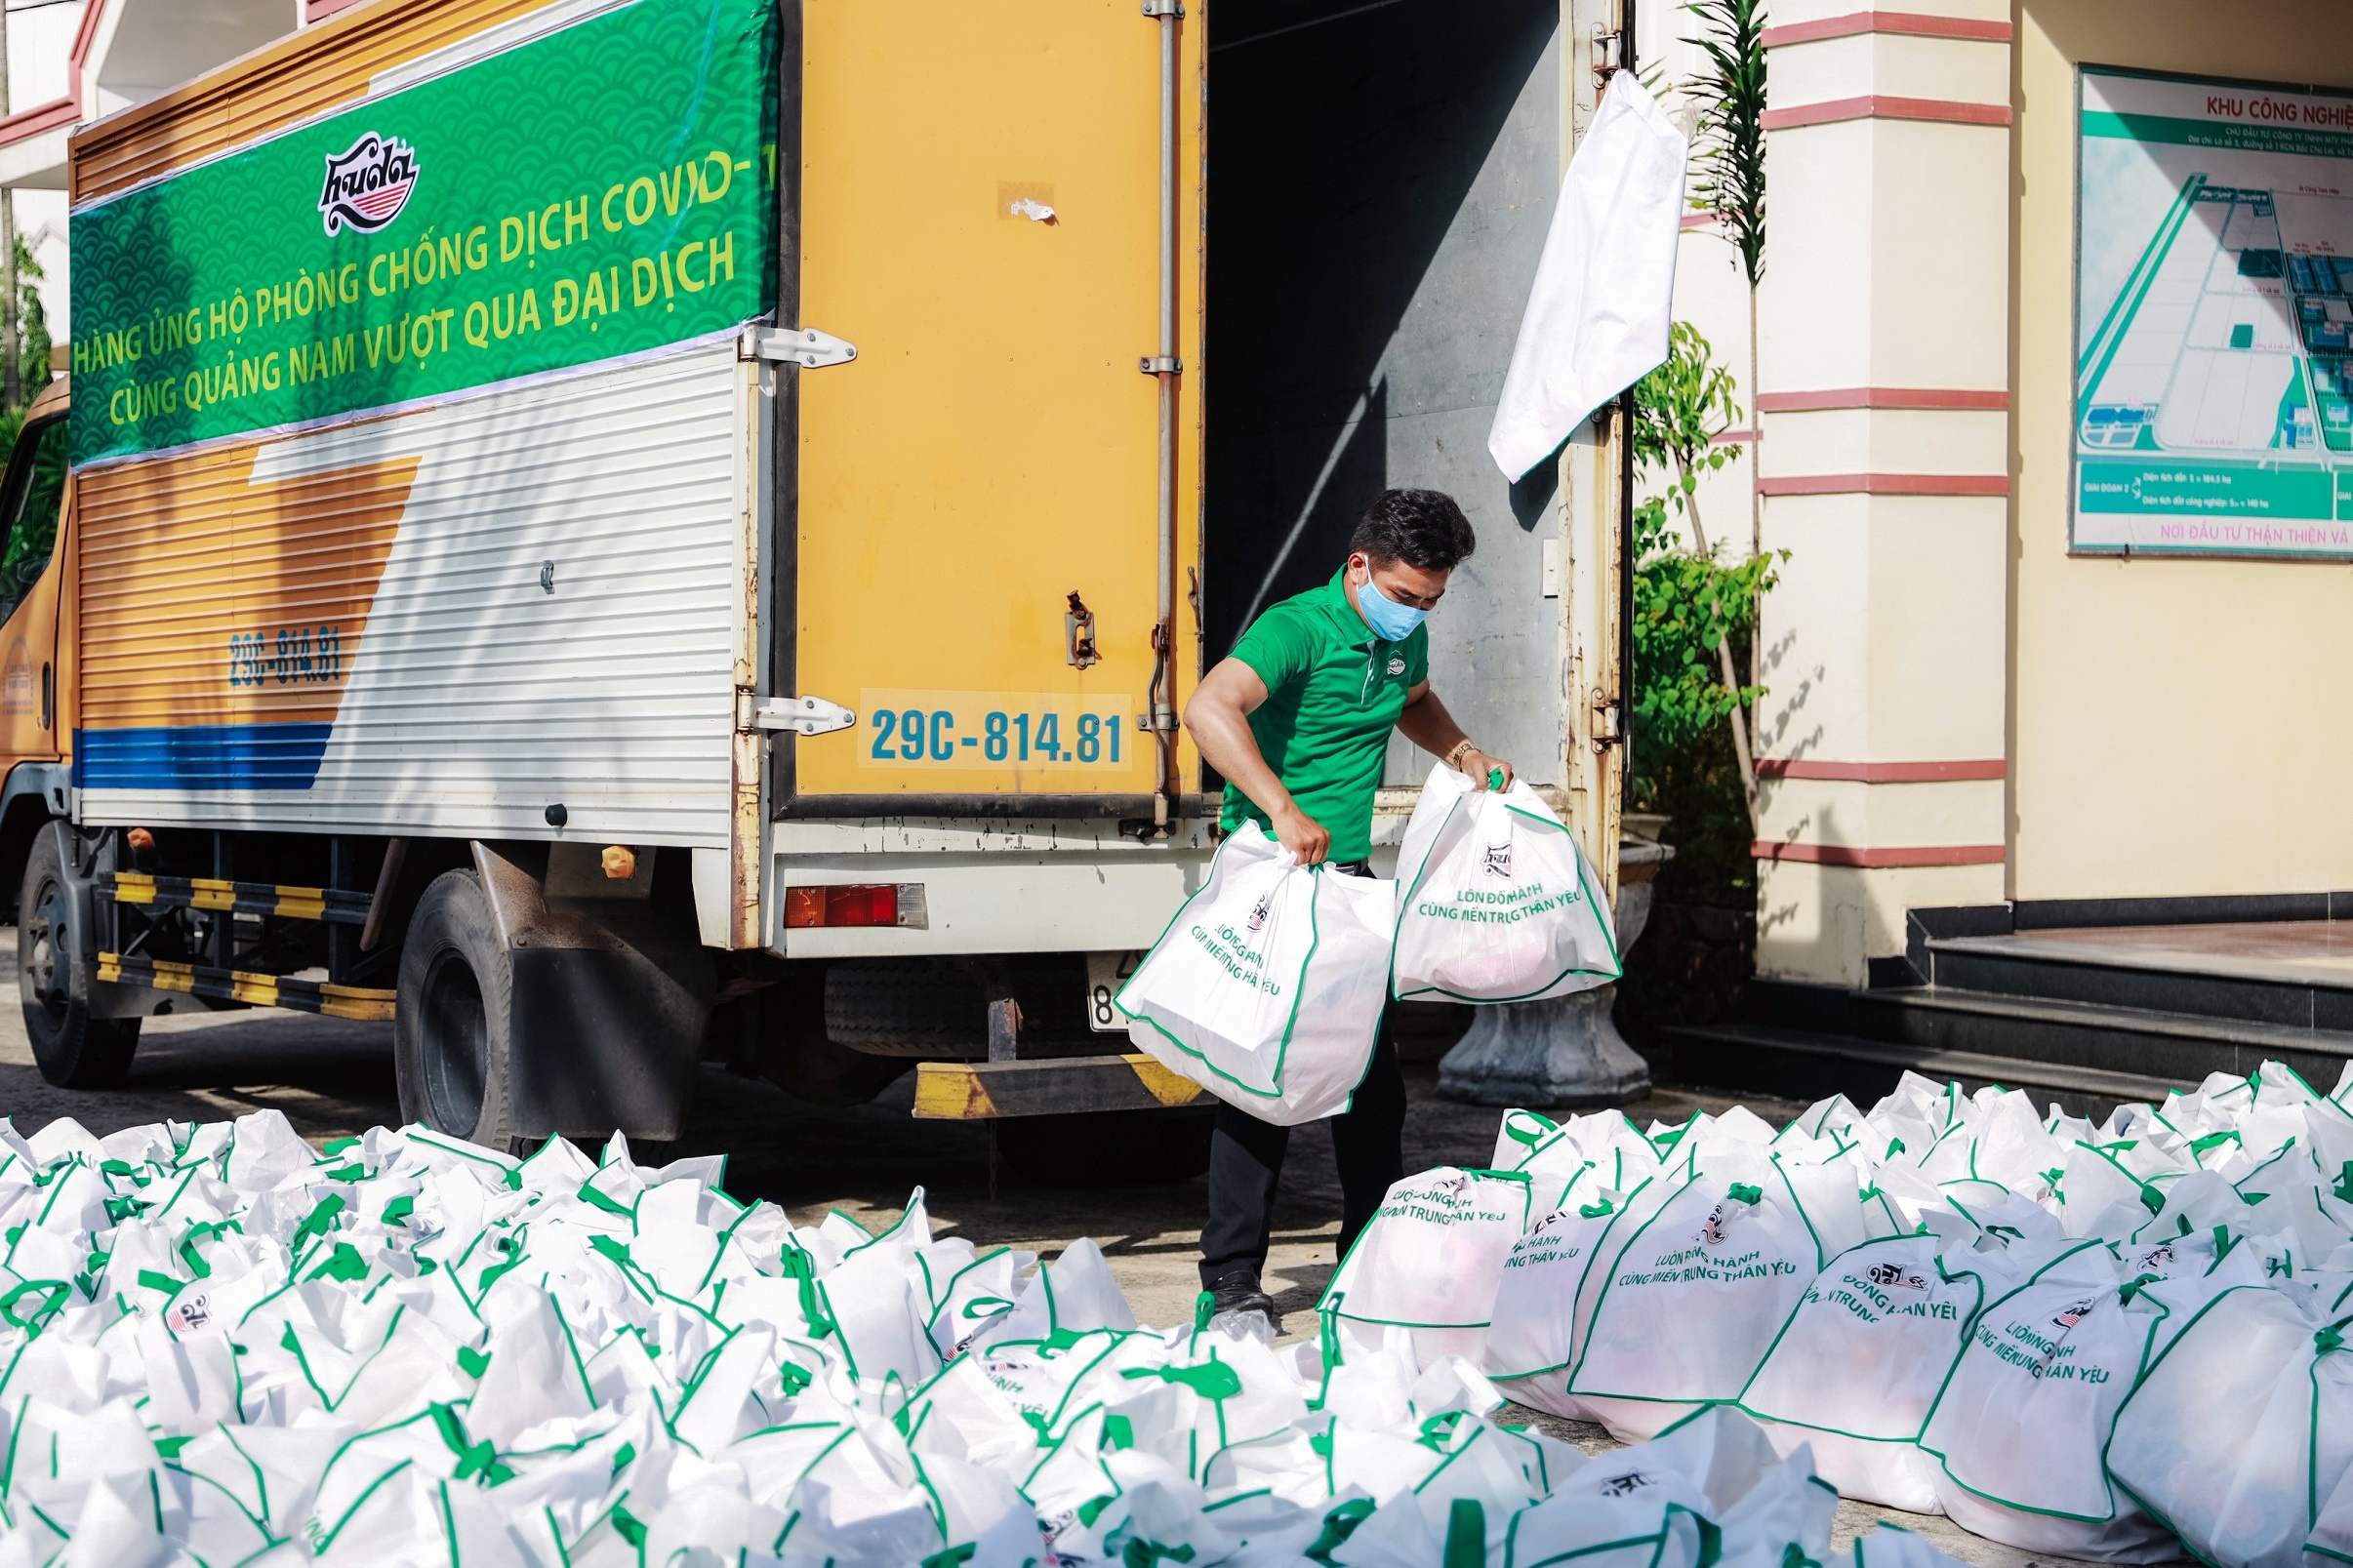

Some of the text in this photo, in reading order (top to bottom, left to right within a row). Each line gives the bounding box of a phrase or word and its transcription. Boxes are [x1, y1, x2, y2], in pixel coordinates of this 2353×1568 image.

[2207, 96, 2244, 118] KHU
[2249, 97, 2298, 122] CÔNG
[73, 328, 142, 376] HÀNG
[149, 307, 202, 355] ỦNG
[210, 287, 249, 344] HỘ
[256, 262, 359, 328] PHÒNG
[368, 224, 488, 297] CHỐNG
[500, 194, 589, 269] DỊCH
[109, 230, 735, 425] CÙNG QUẢNG NAM VƯỢT QUA ĐẠI DỊCH
[2161, 523, 2184, 540] NƠI
[872, 709, 1120, 763] 29C-814.81
[1418, 902, 1458, 920] CÙNG
[1520, 898, 1556, 918] THÂN
[1408, 1205, 1451, 1226] TRUNG
[1526, 1233, 1562, 1249] HÀNH
[1528, 1249, 1558, 1266] THÂN
[1654, 1249, 1684, 1267] LUÔN
[1713, 1250, 1761, 1268] HÀNH
[1618, 1270, 1651, 1287] CÙNG
[1649, 1267, 1682, 1284] MIỀN
[1722, 1264, 1767, 1283] THÂN
[1843, 1274, 1889, 1309] ĐỒNG
[1975, 1323, 1999, 1348] CÙNG
[2079, 1365, 2110, 1385] YÊU
